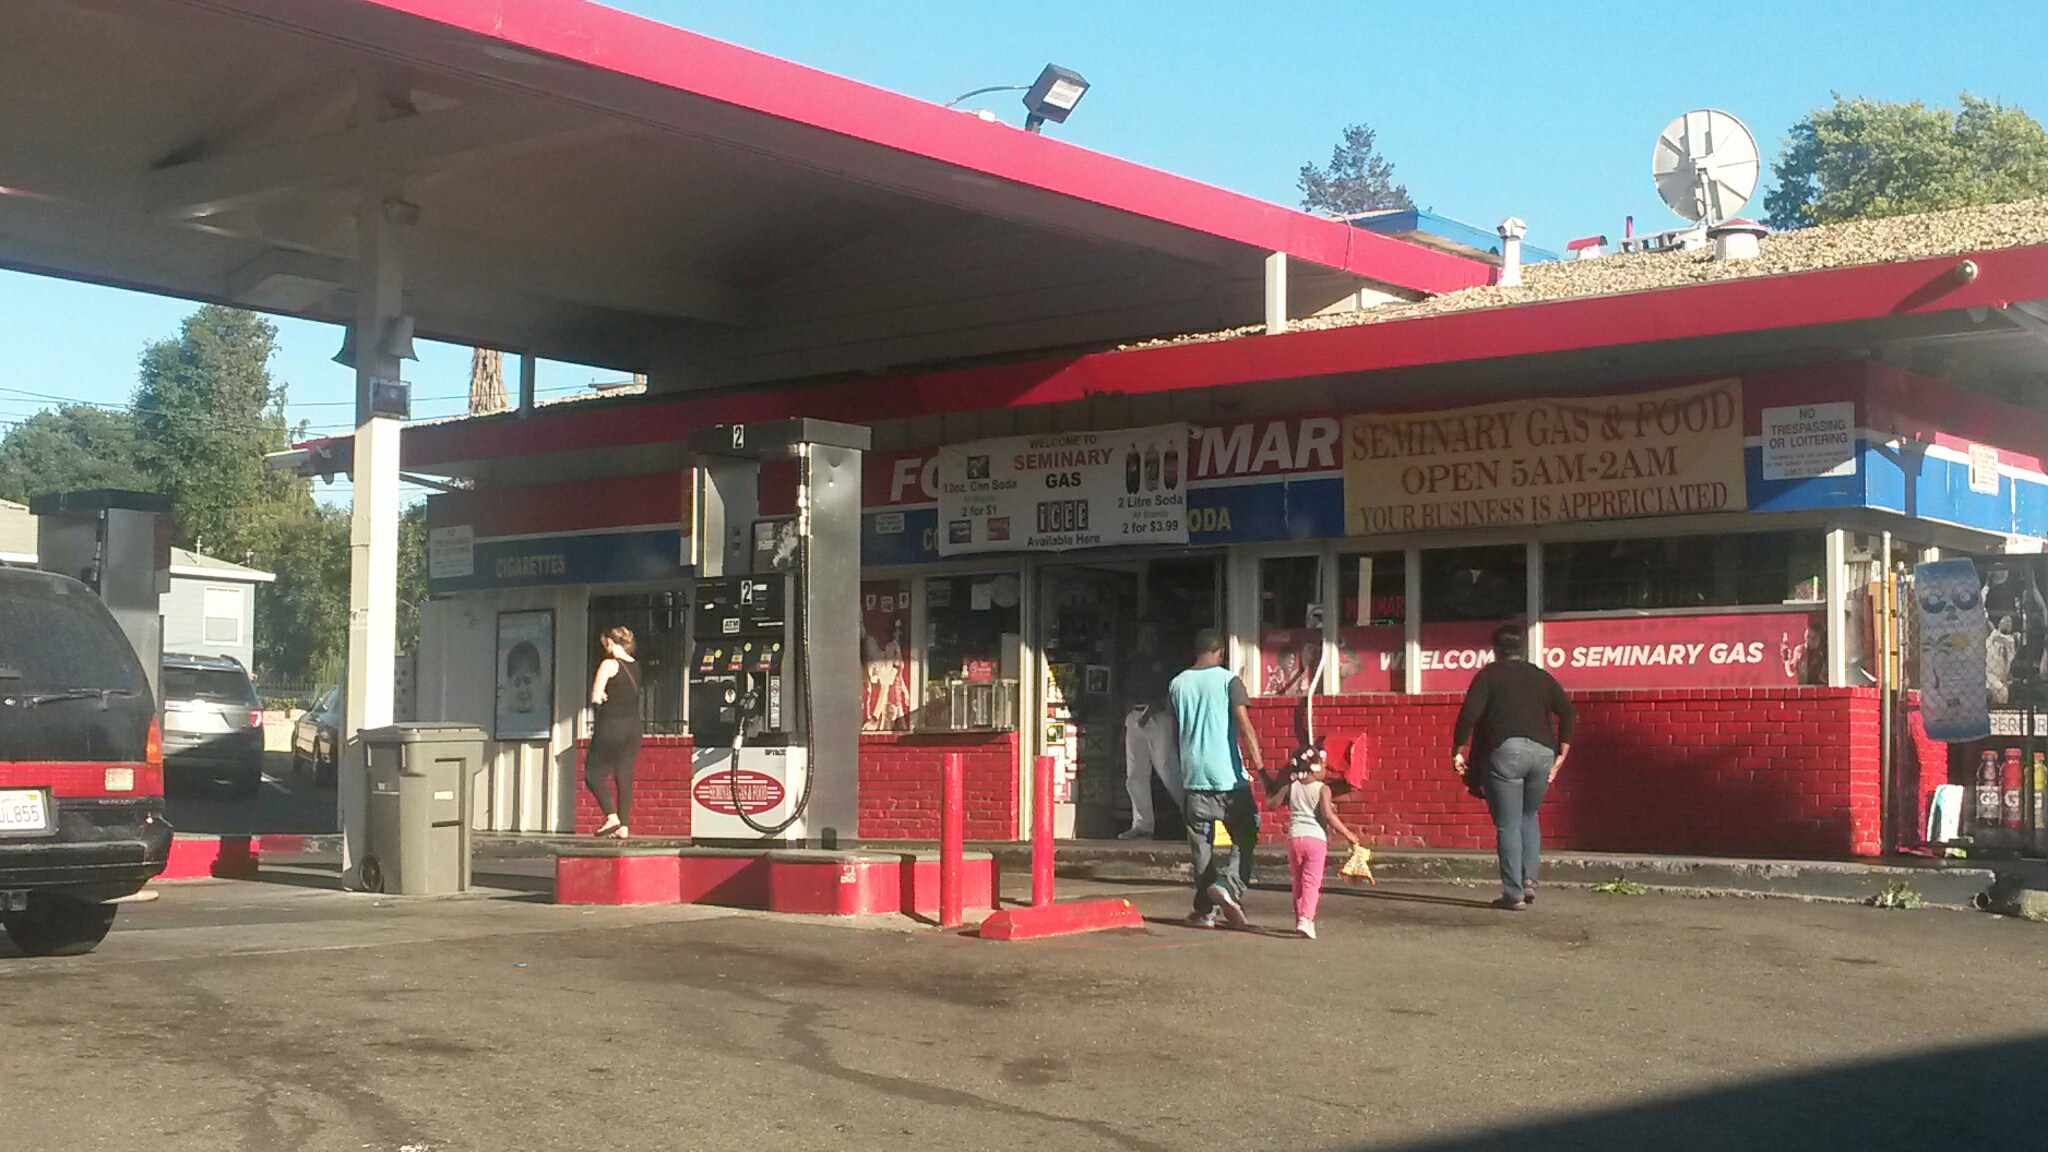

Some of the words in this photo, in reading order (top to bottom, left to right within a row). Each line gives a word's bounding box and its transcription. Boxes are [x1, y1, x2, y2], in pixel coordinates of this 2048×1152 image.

[1799, 408, 1816, 419] NO
[1352, 411, 1517, 461] SEMINARY
[1526, 408, 1590, 446] GAS
[1601, 405, 1625, 441] &
[1634, 389, 1735, 438] FOOD
[1771, 419, 1846, 436] TRESPASSING
[734, 425, 743, 447] 2
[1029, 436, 1080, 449] WELCOME
[1083, 434, 1097, 445] TO
[1769, 437, 1785, 449] OR
[1790, 432, 1848, 448] LOITERING
[1197, 417, 1341, 477] MAR
[1014, 448, 1113, 471] SEMINARY
[1402, 460, 1500, 494] OPEN
[1511, 445, 1678, 487] 5AM-2AM
[970, 481, 989, 492] Can
[992, 479, 1018, 490] Soda
[1045, 471, 1082, 488] GAS
[1118, 497, 1124, 508] 2
[1127, 496, 1153, 508] Litre
[1154, 494, 1183, 506] Soda
[1358, 504, 1416, 532] YOUR
[1422, 498, 1524, 528] BUSINESS
[1531, 494, 1551, 522] IS
[1557, 481, 1728, 520] APPREICIATED
[961, 507, 967, 517] 2
[970, 505, 984, 516] for
[986, 504, 997, 515] $1
[1037, 499, 1089, 533] ICEE
[1122, 523, 1129, 534] 2
[1132, 522, 1147, 533] for
[1150, 520, 1179, 533] $3.99
[1188, 506, 1233, 533] ODA
[1027, 535, 1073, 547] Available
[1076, 534, 1100, 545] Here
[496, 553, 566, 578] CIGARETTES
[742, 582, 751, 604] 2
[723, 619, 739, 628] ATM
[1380, 648, 1496, 671] WELCOM
[1571, 643, 1704, 667] SEMINARY
[1708, 642, 1764, 664] GAS
[1979, 791, 1999, 806] G2
